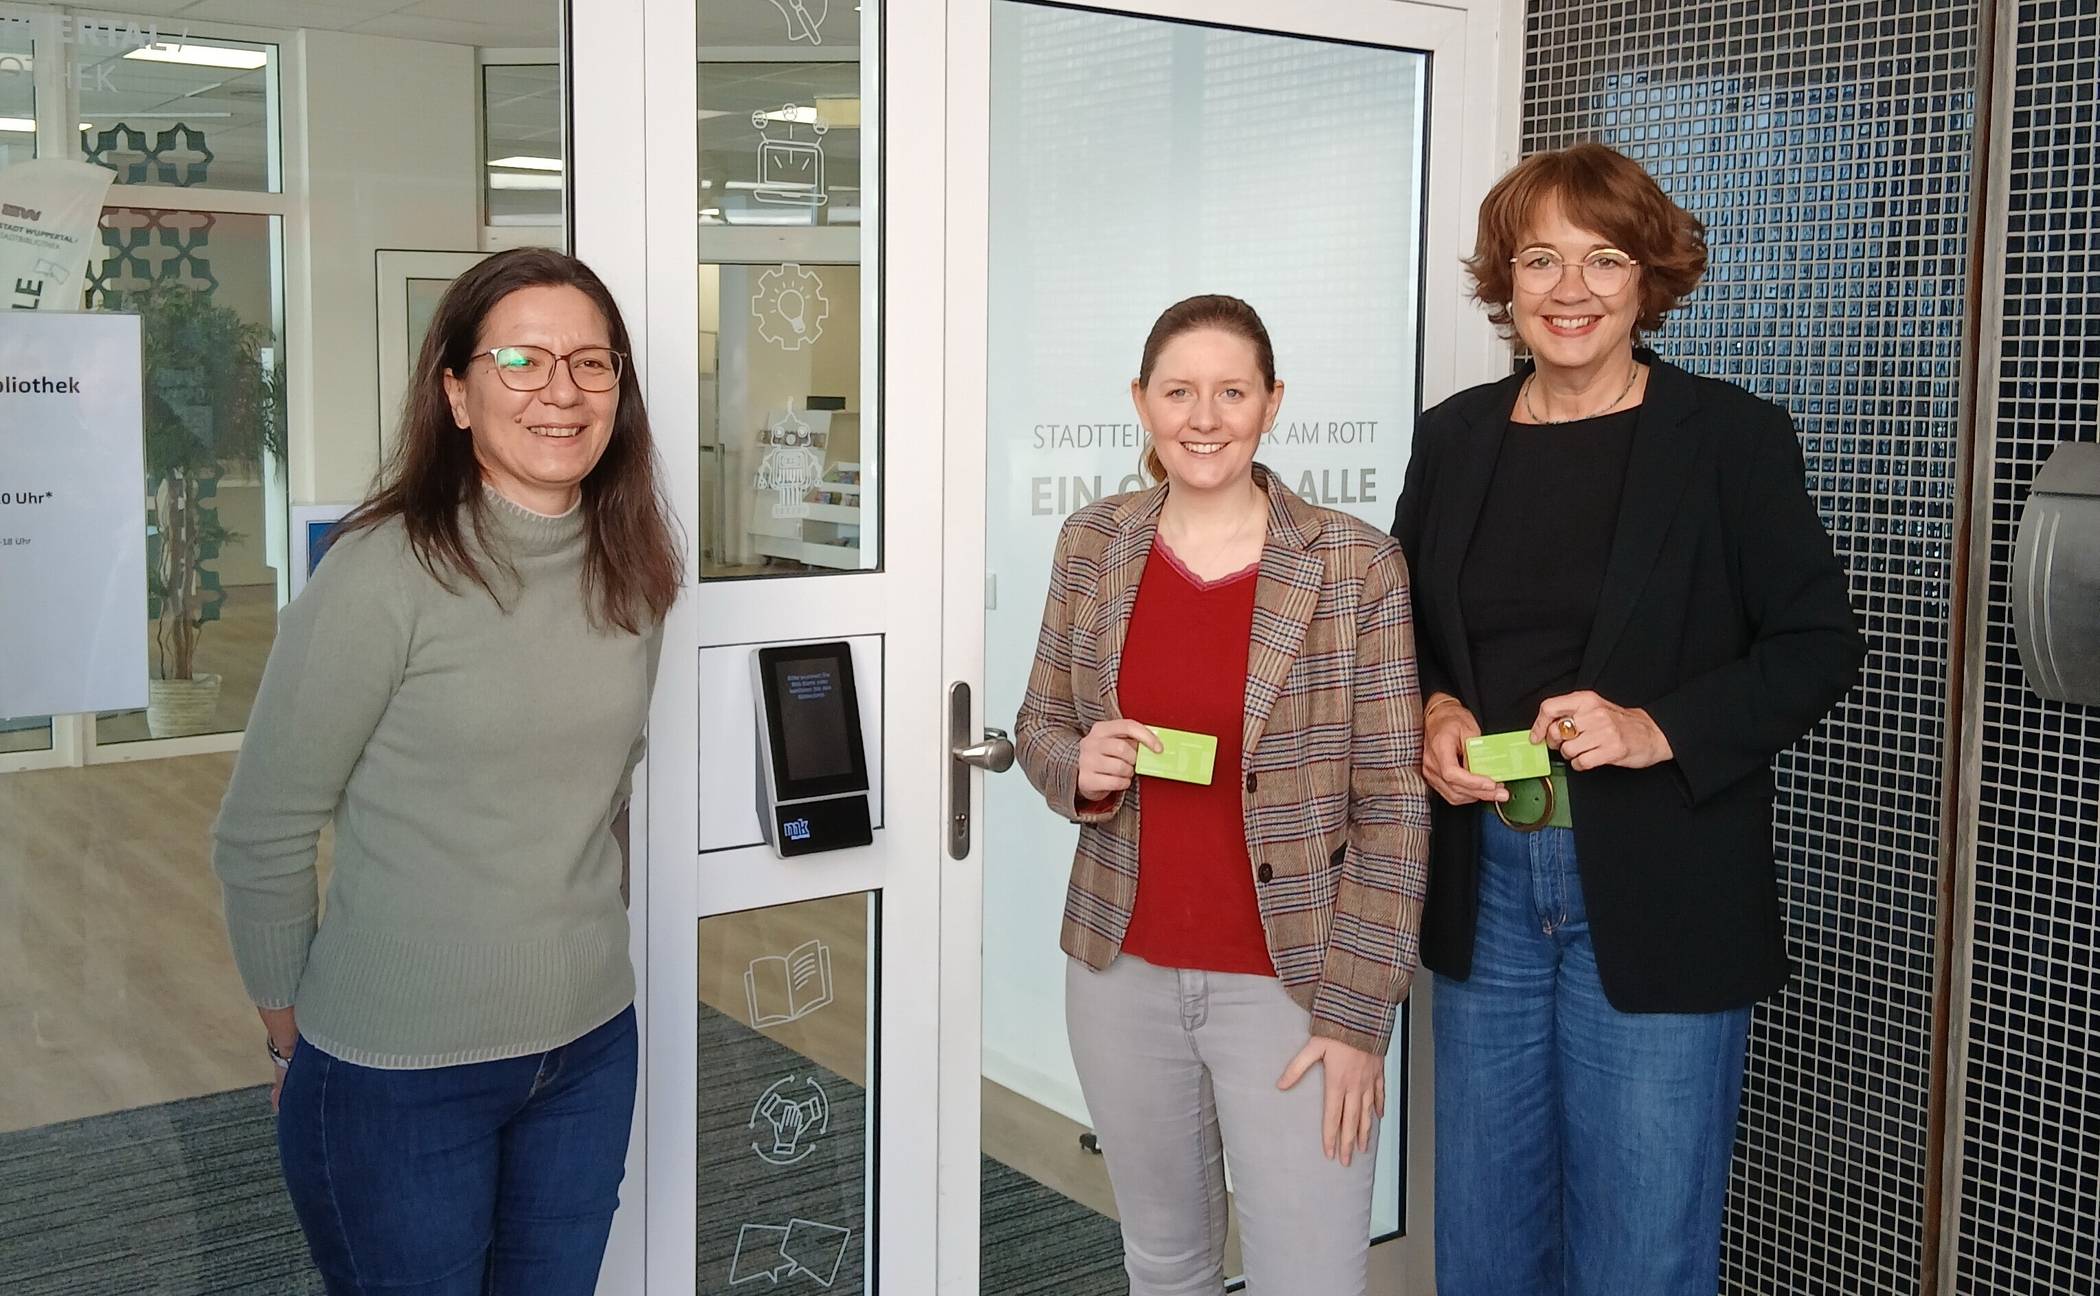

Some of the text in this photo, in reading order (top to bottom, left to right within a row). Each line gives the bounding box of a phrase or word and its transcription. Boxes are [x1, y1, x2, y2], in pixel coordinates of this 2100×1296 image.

[1285, 422, 1319, 445] AM
[1328, 421, 1378, 444] ROTT
[1031, 475, 1102, 516] EIN
[1296, 468, 1377, 504] ALLE
